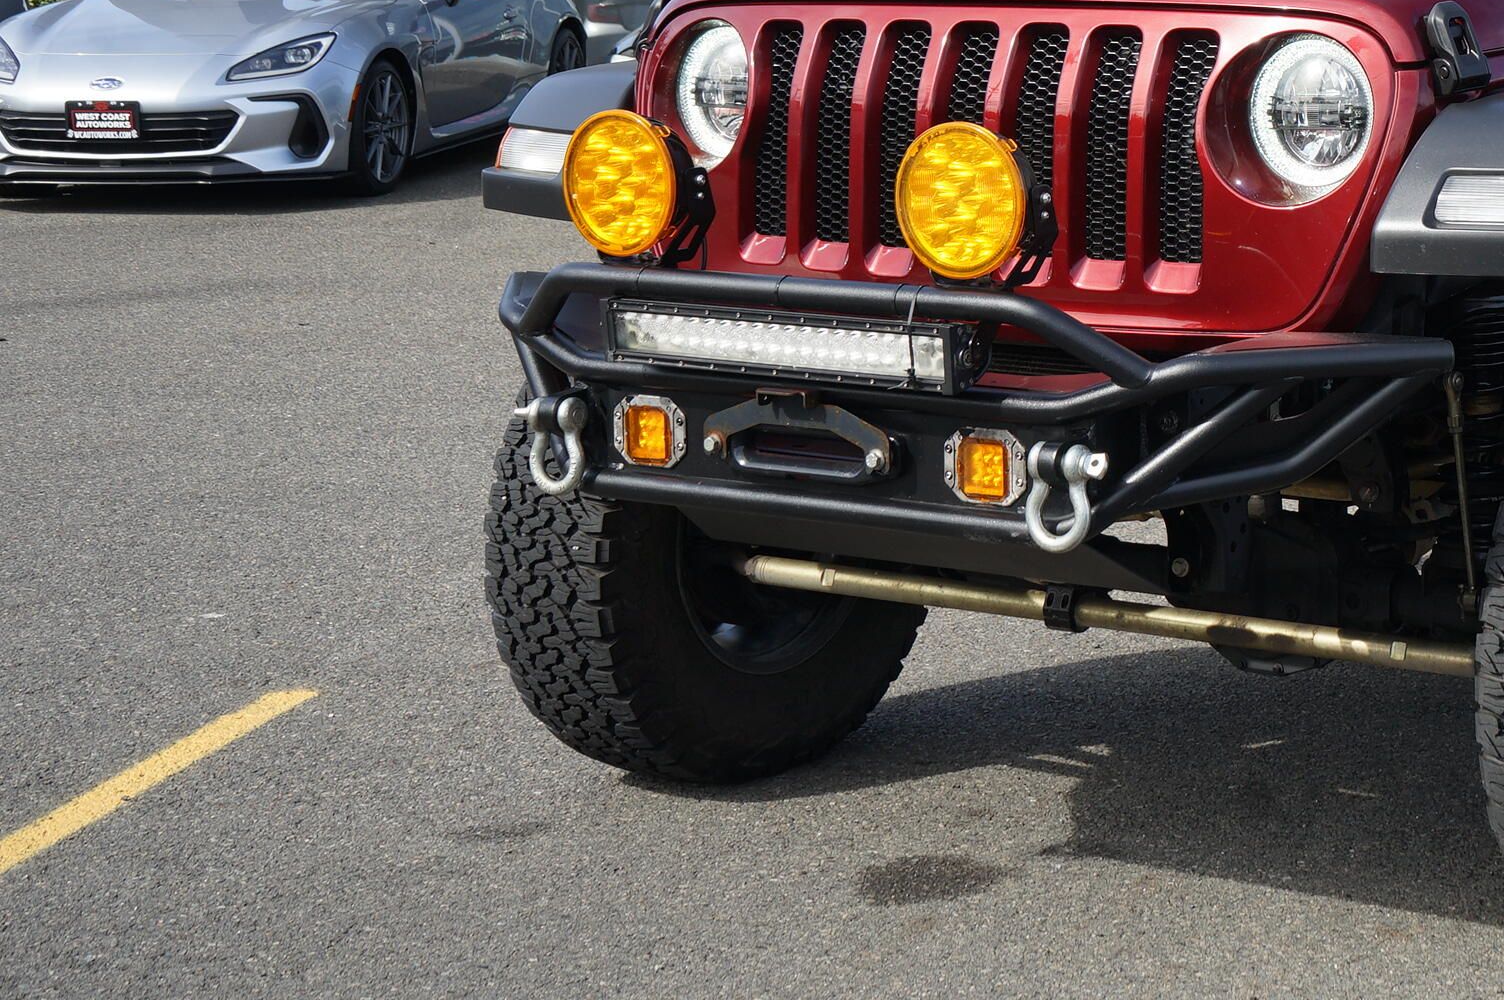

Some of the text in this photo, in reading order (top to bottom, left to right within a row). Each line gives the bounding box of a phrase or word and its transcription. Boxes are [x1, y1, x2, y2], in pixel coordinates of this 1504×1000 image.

[75, 112, 131, 121] WEST COAST
[76, 120, 132, 129] AUTOWORKS
